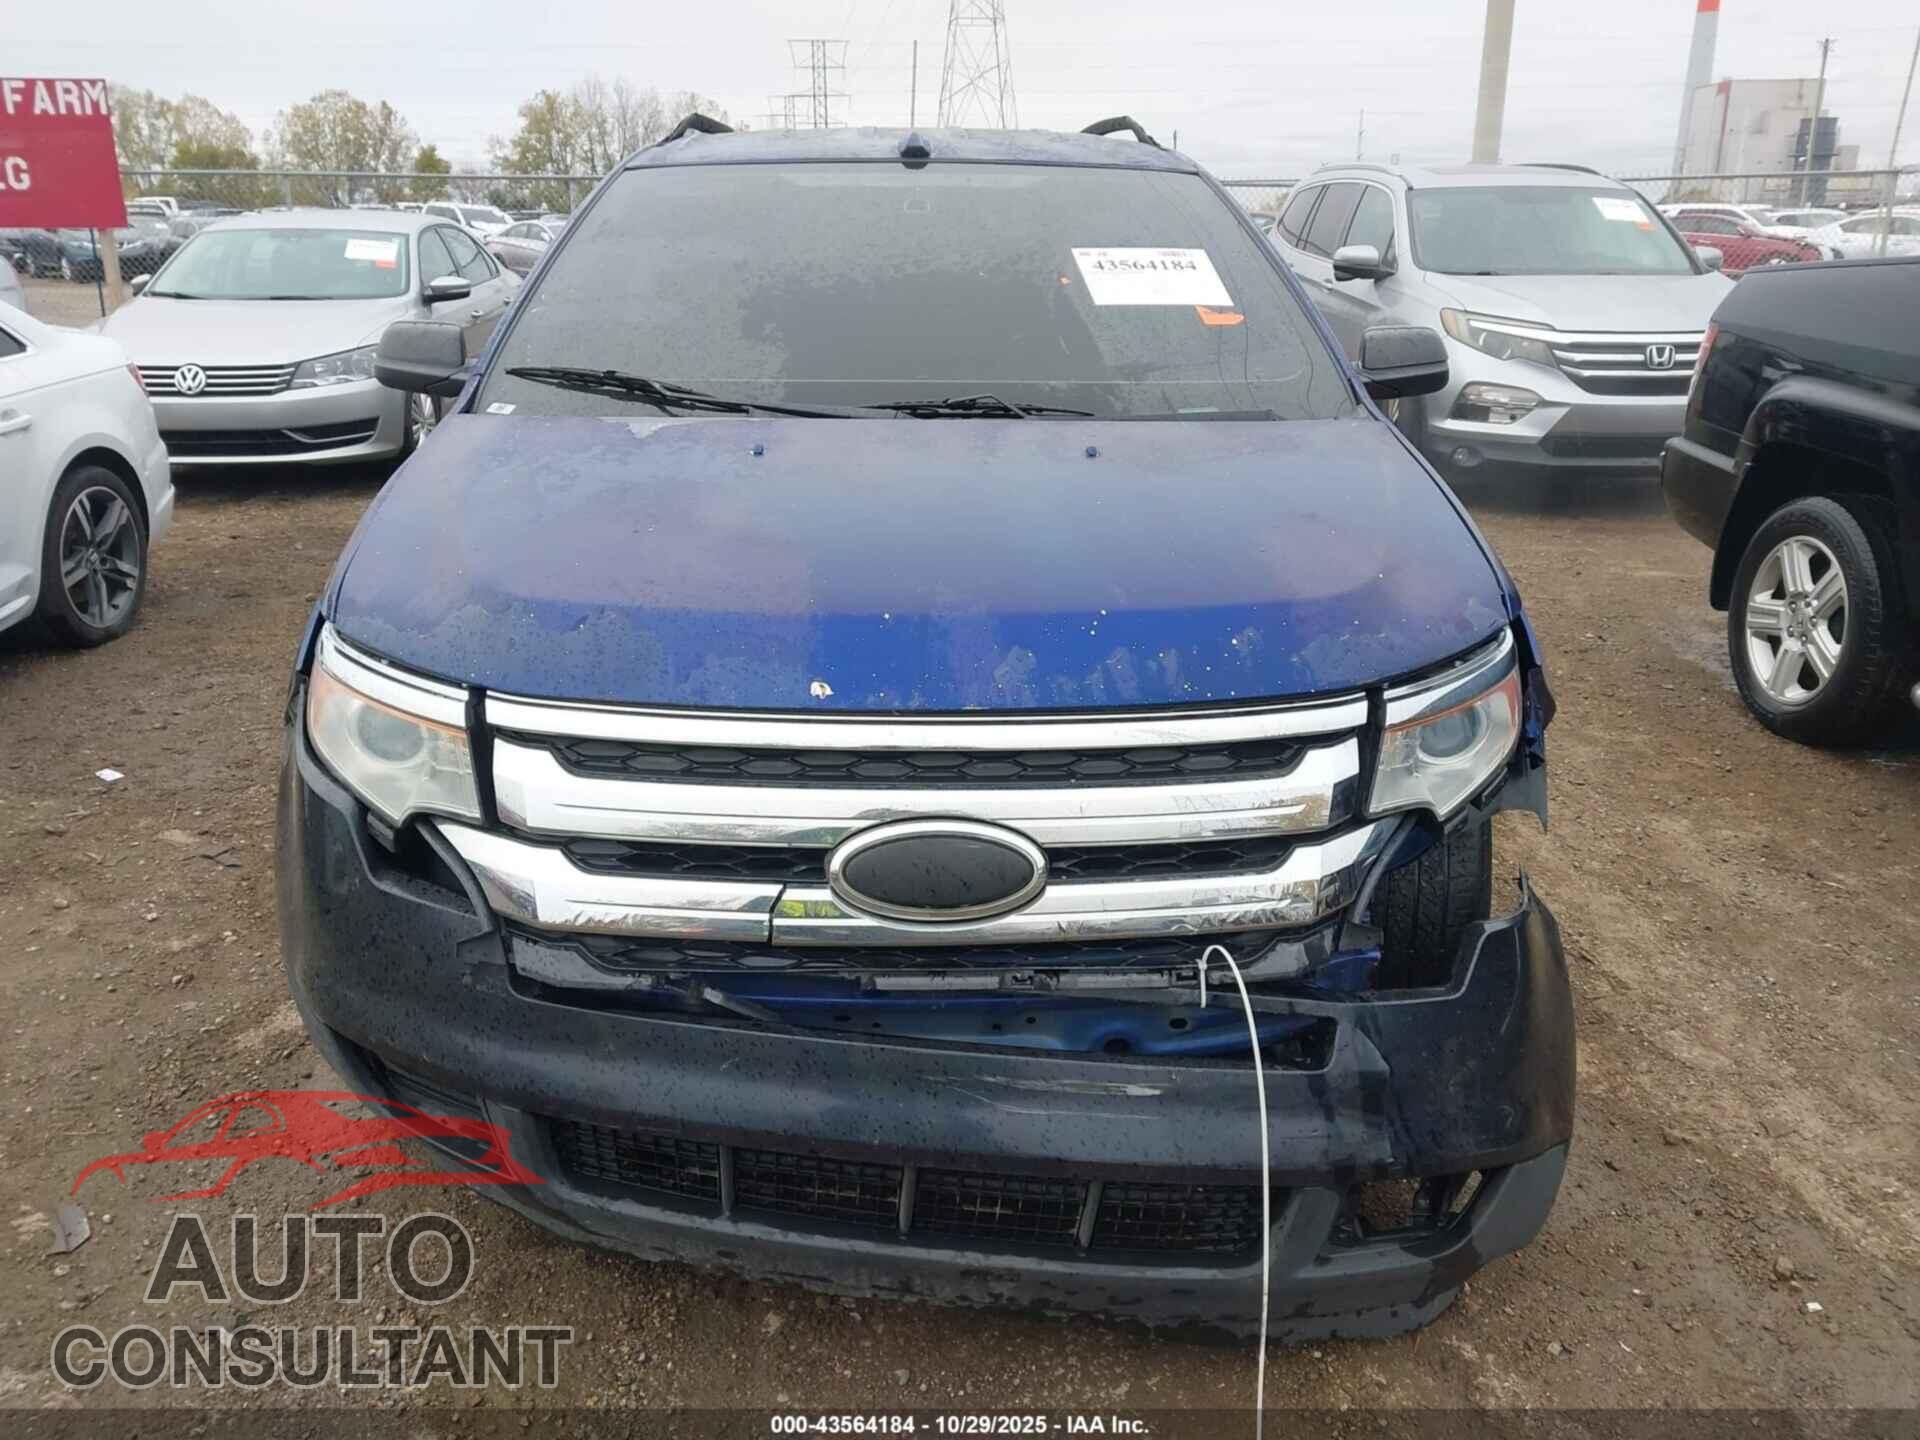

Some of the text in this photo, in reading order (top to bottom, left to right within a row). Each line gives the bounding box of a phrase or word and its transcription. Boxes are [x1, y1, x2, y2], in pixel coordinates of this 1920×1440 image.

[2, 79, 109, 115] FARM
[0, 156, 31, 190] G
[1093, 259, 1199, 272] 43564184
